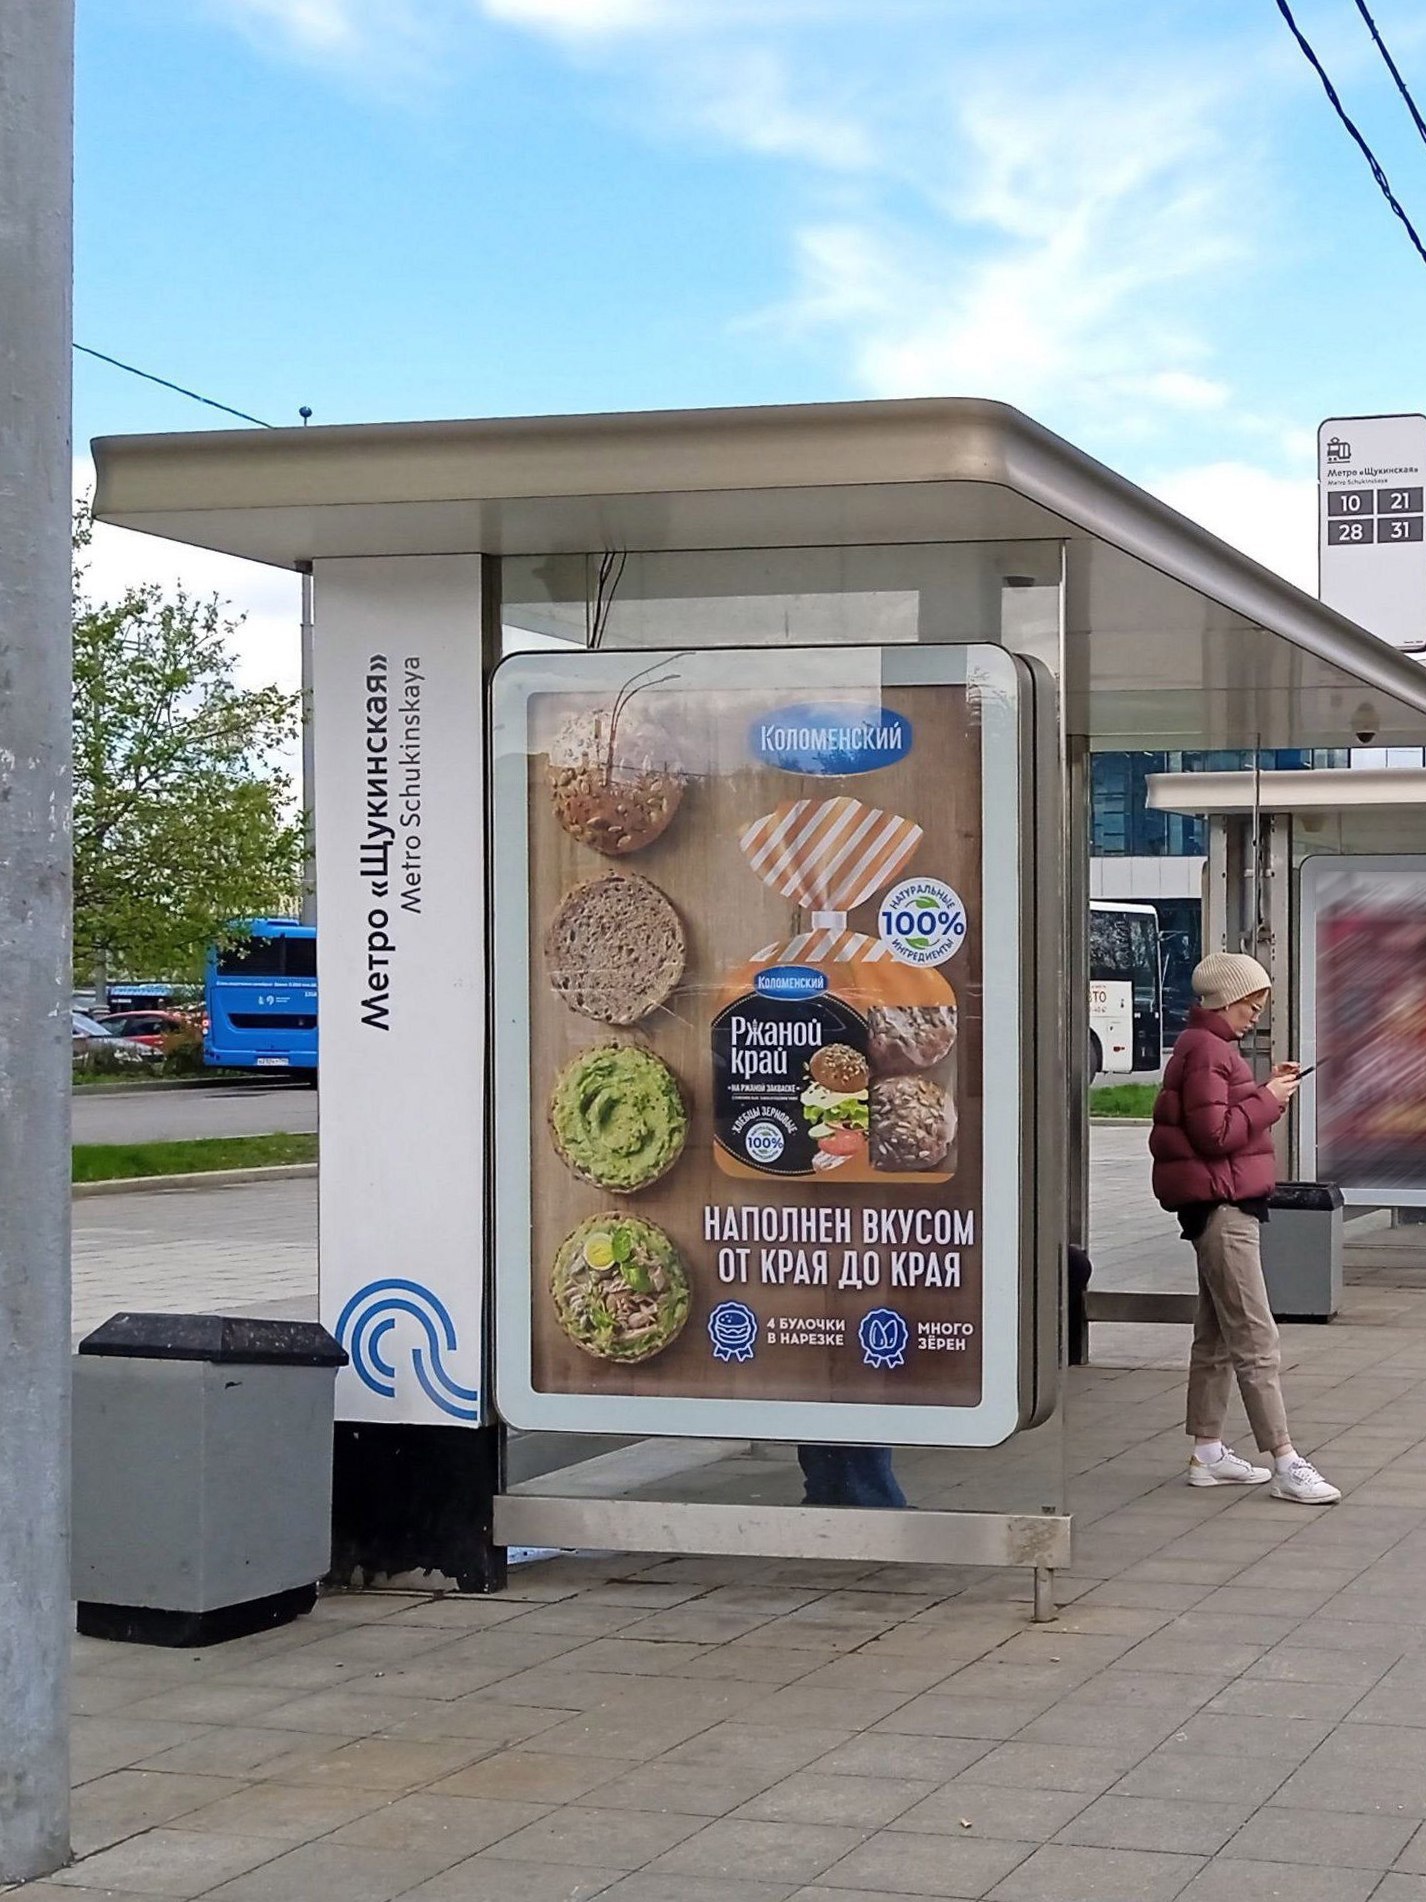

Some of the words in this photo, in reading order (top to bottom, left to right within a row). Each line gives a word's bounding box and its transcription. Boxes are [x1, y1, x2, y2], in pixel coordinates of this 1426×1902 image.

[1327, 469, 1358, 478] Метро
[1359, 466, 1419, 477] «Щукинская»
[1341, 495, 1361, 511] 10
[1390, 492, 1410, 509] 21
[1339, 524, 1363, 541] 28
[1390, 521, 1410, 539] 31
[398, 655, 426, 827] Schukinskaya
[360, 652, 395, 899] «Щукинская»
[400, 834, 422, 914] Metro
[890, 885, 955, 910] НАТУРАЛЬНЫЕ
[881, 911, 965, 936] 100%
[892, 938, 954, 962] ИНГРЕДИЕНТЫ
[361, 908, 396, 1031] Метро
[731, 1016, 822, 1046] Ржаной
[731, 1047, 788, 1080] край
[731, 1084, 740, 1092] НА
[740, 1083, 766, 1092] РЖАНОЙ
[766, 1084, 796, 1093] ЗАКВАСКЕ
[761, 1106, 798, 1134] ЗЕРНОВЫЕ
[748, 1137, 784, 1149] 100%
[704, 1205, 851, 1243] НАПОЛНЕН
[863, 1208, 974, 1245] ВКУСОМ
[718, 1248, 750, 1283] ОТ
[761, 1249, 828, 1285] КРАЯ
[838, 1250, 880, 1290] ДО
[891, 1251, 960, 1287] КРАЯ
[766, 1318, 776, 1329] 4
[779, 1318, 846, 1331] БУЛОЧКИ
[917, 1323, 974, 1336] МНОГО
[767, 1333, 776, 1344] В
[780, 1333, 844, 1346] НАРЕЗКЕ
[917, 1337, 966, 1351] ЗЁРЕН
